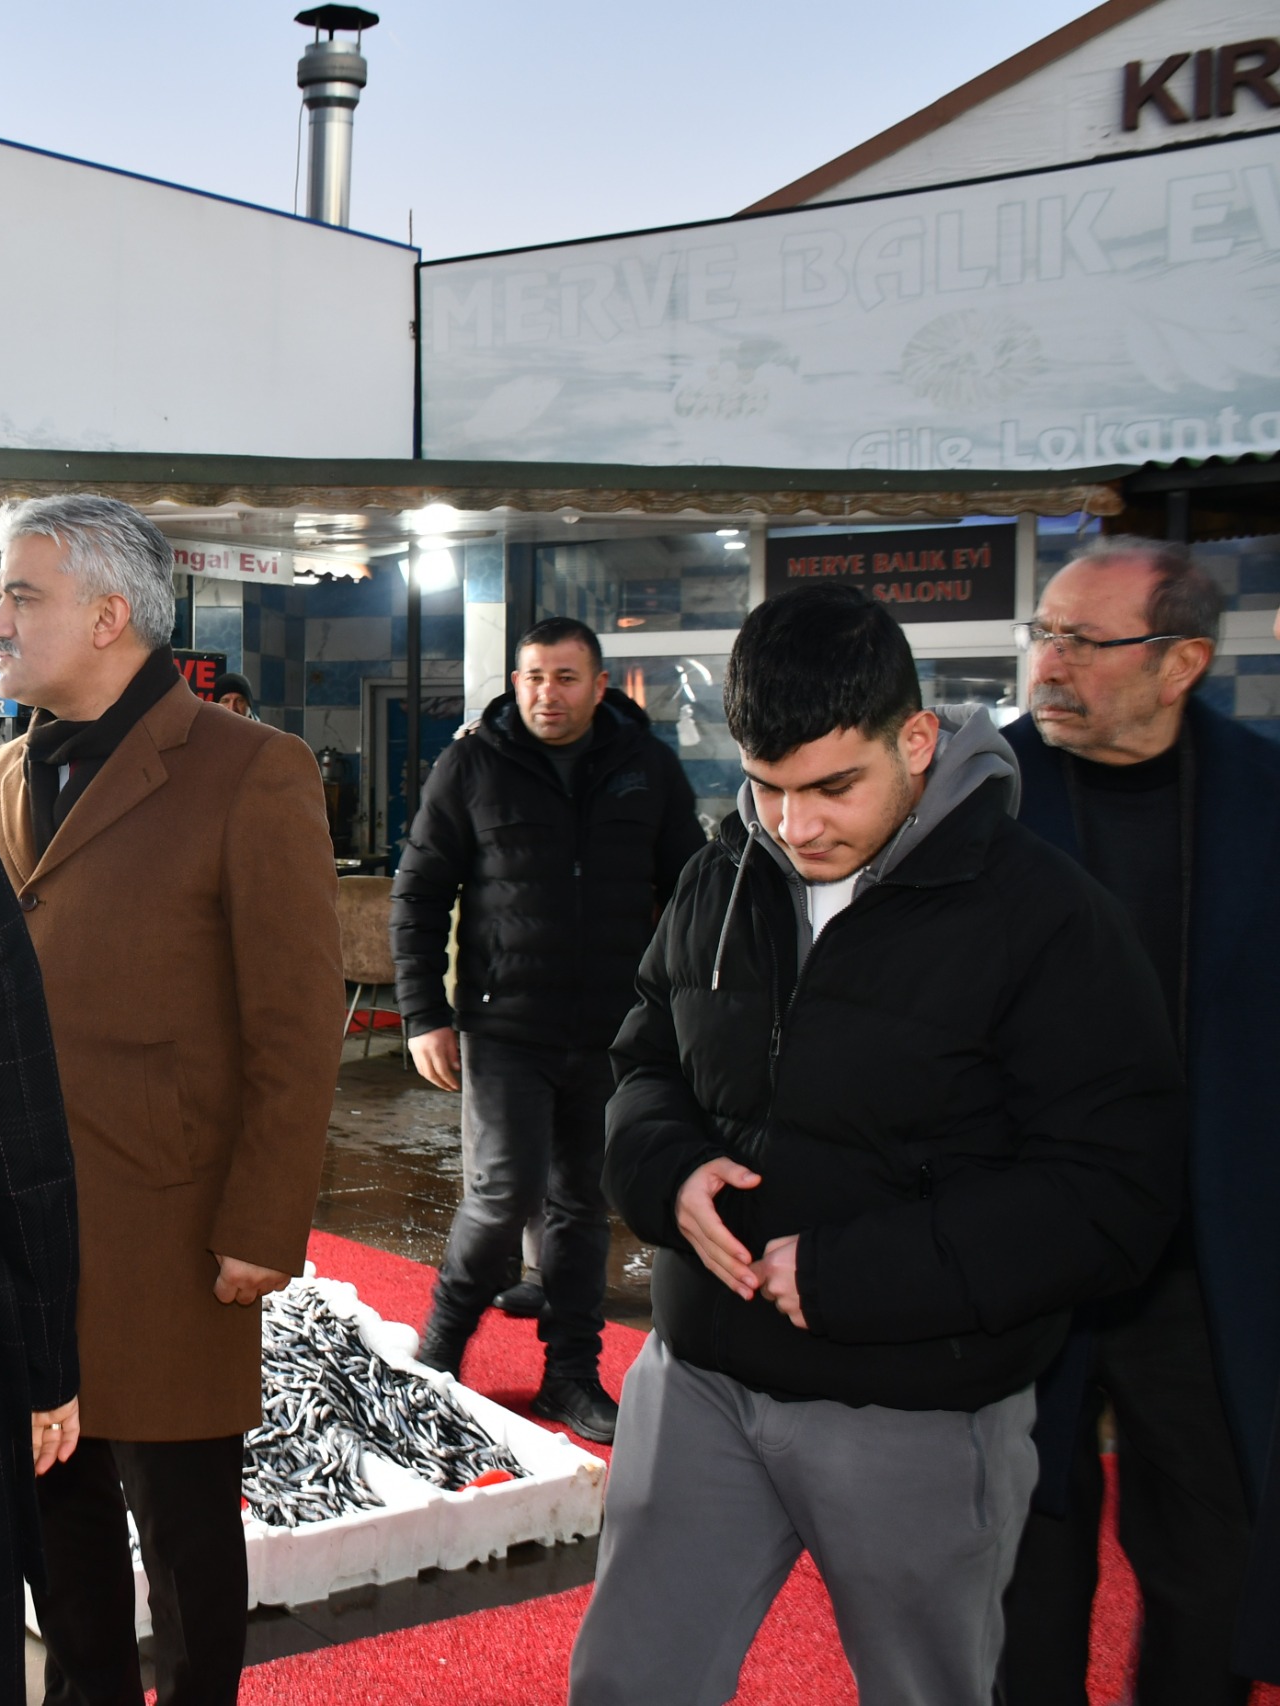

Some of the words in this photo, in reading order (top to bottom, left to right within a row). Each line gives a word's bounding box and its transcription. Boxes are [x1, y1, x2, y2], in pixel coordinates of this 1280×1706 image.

[1122, 36, 1280, 131] KIR
[431, 242, 739, 355] MERVE
[779, 187, 1117, 313] BALIK
[239, 552, 278, 575] Evi
[787, 553, 865, 577] MERVE
[873, 549, 946, 574] BALIK
[873, 580, 973, 604] SALONU
